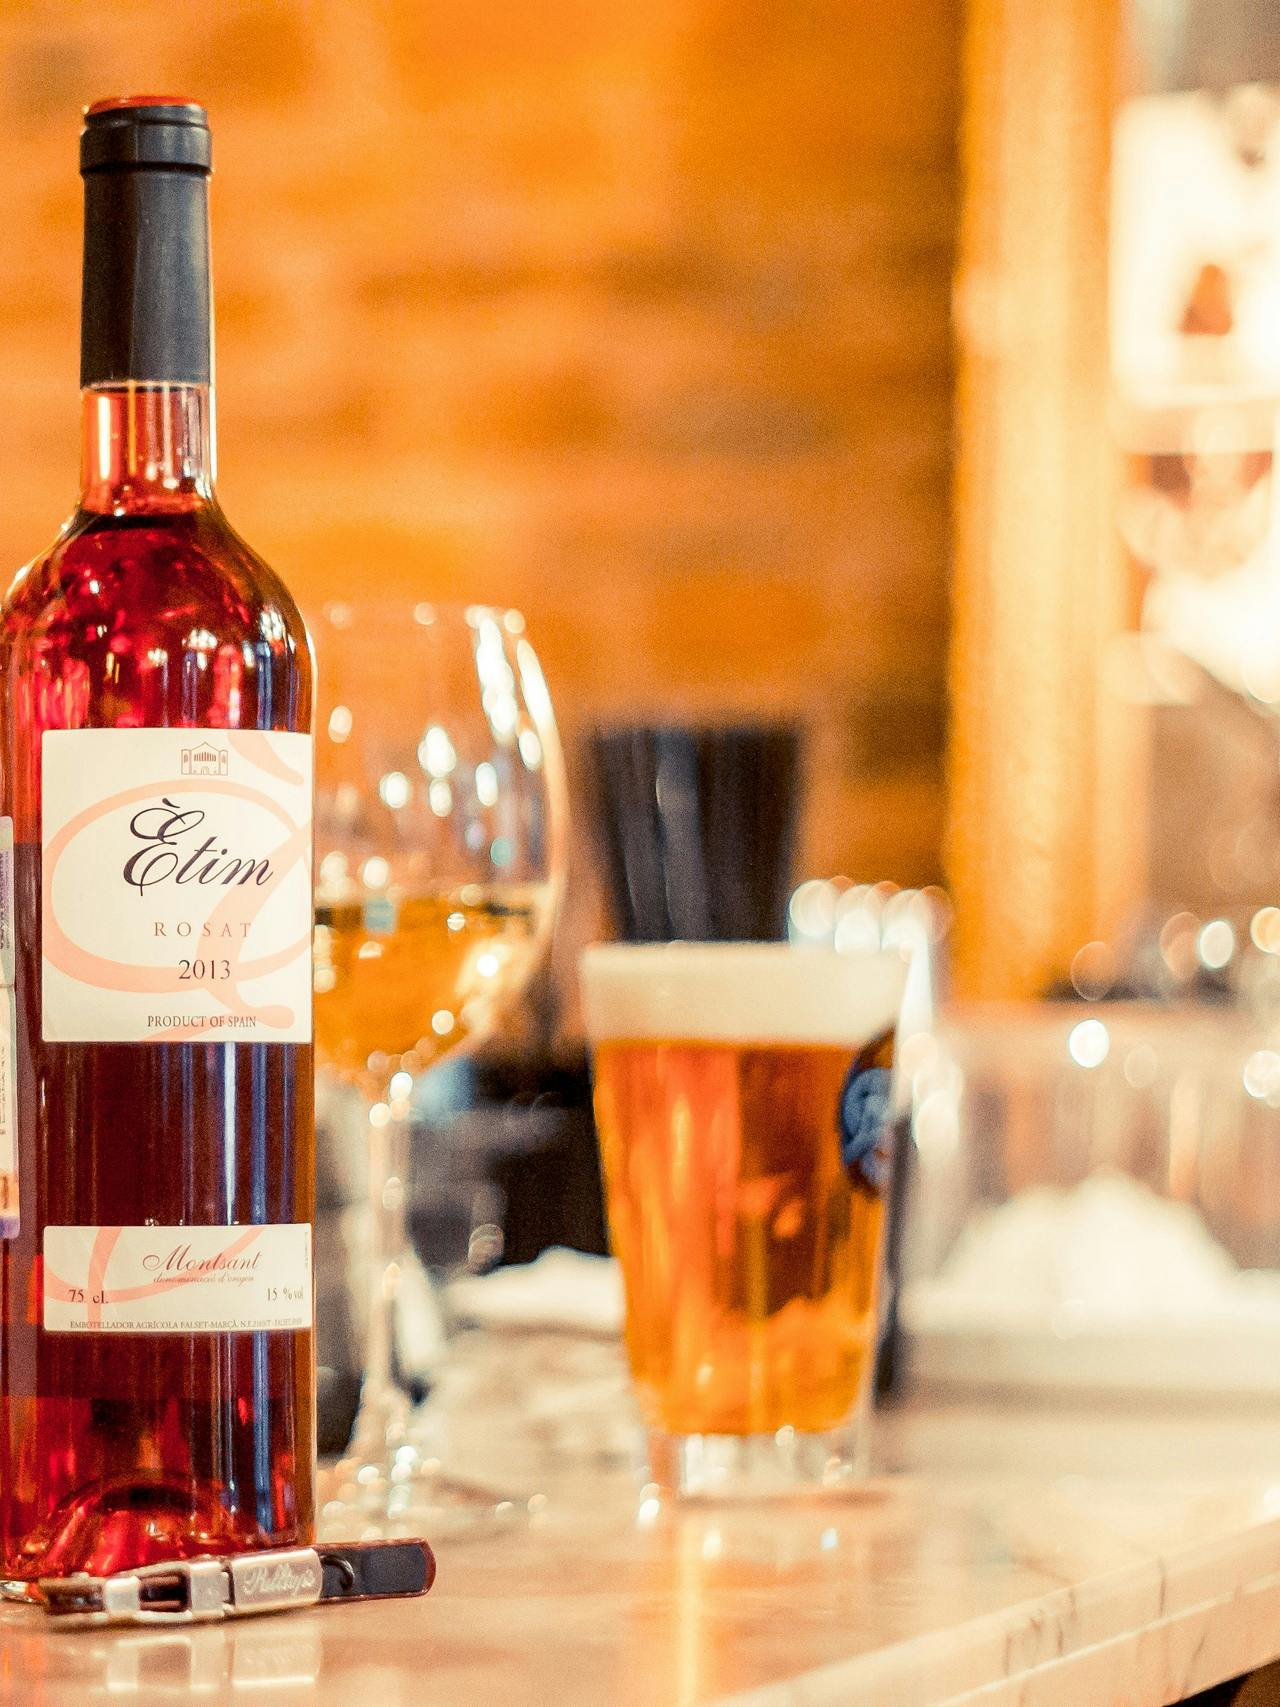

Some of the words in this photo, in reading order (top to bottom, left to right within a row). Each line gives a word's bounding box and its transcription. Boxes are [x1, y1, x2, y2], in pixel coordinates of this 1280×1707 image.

[154, 921, 251, 938] ROSAT
[178, 959, 231, 980] 2013
[147, 1015, 207, 1028] PRODUCT
[209, 1015, 225, 1028] OF
[228, 1015, 256, 1028] SPAIN
[142, 1244, 262, 1271] Montsant
[69, 1289, 84, 1303] 75
[267, 1287, 278, 1301] 15
[70, 1320, 134, 1329] EMBOTELLADOR
[136, 1320, 178, 1329] AGRÍCOLA
